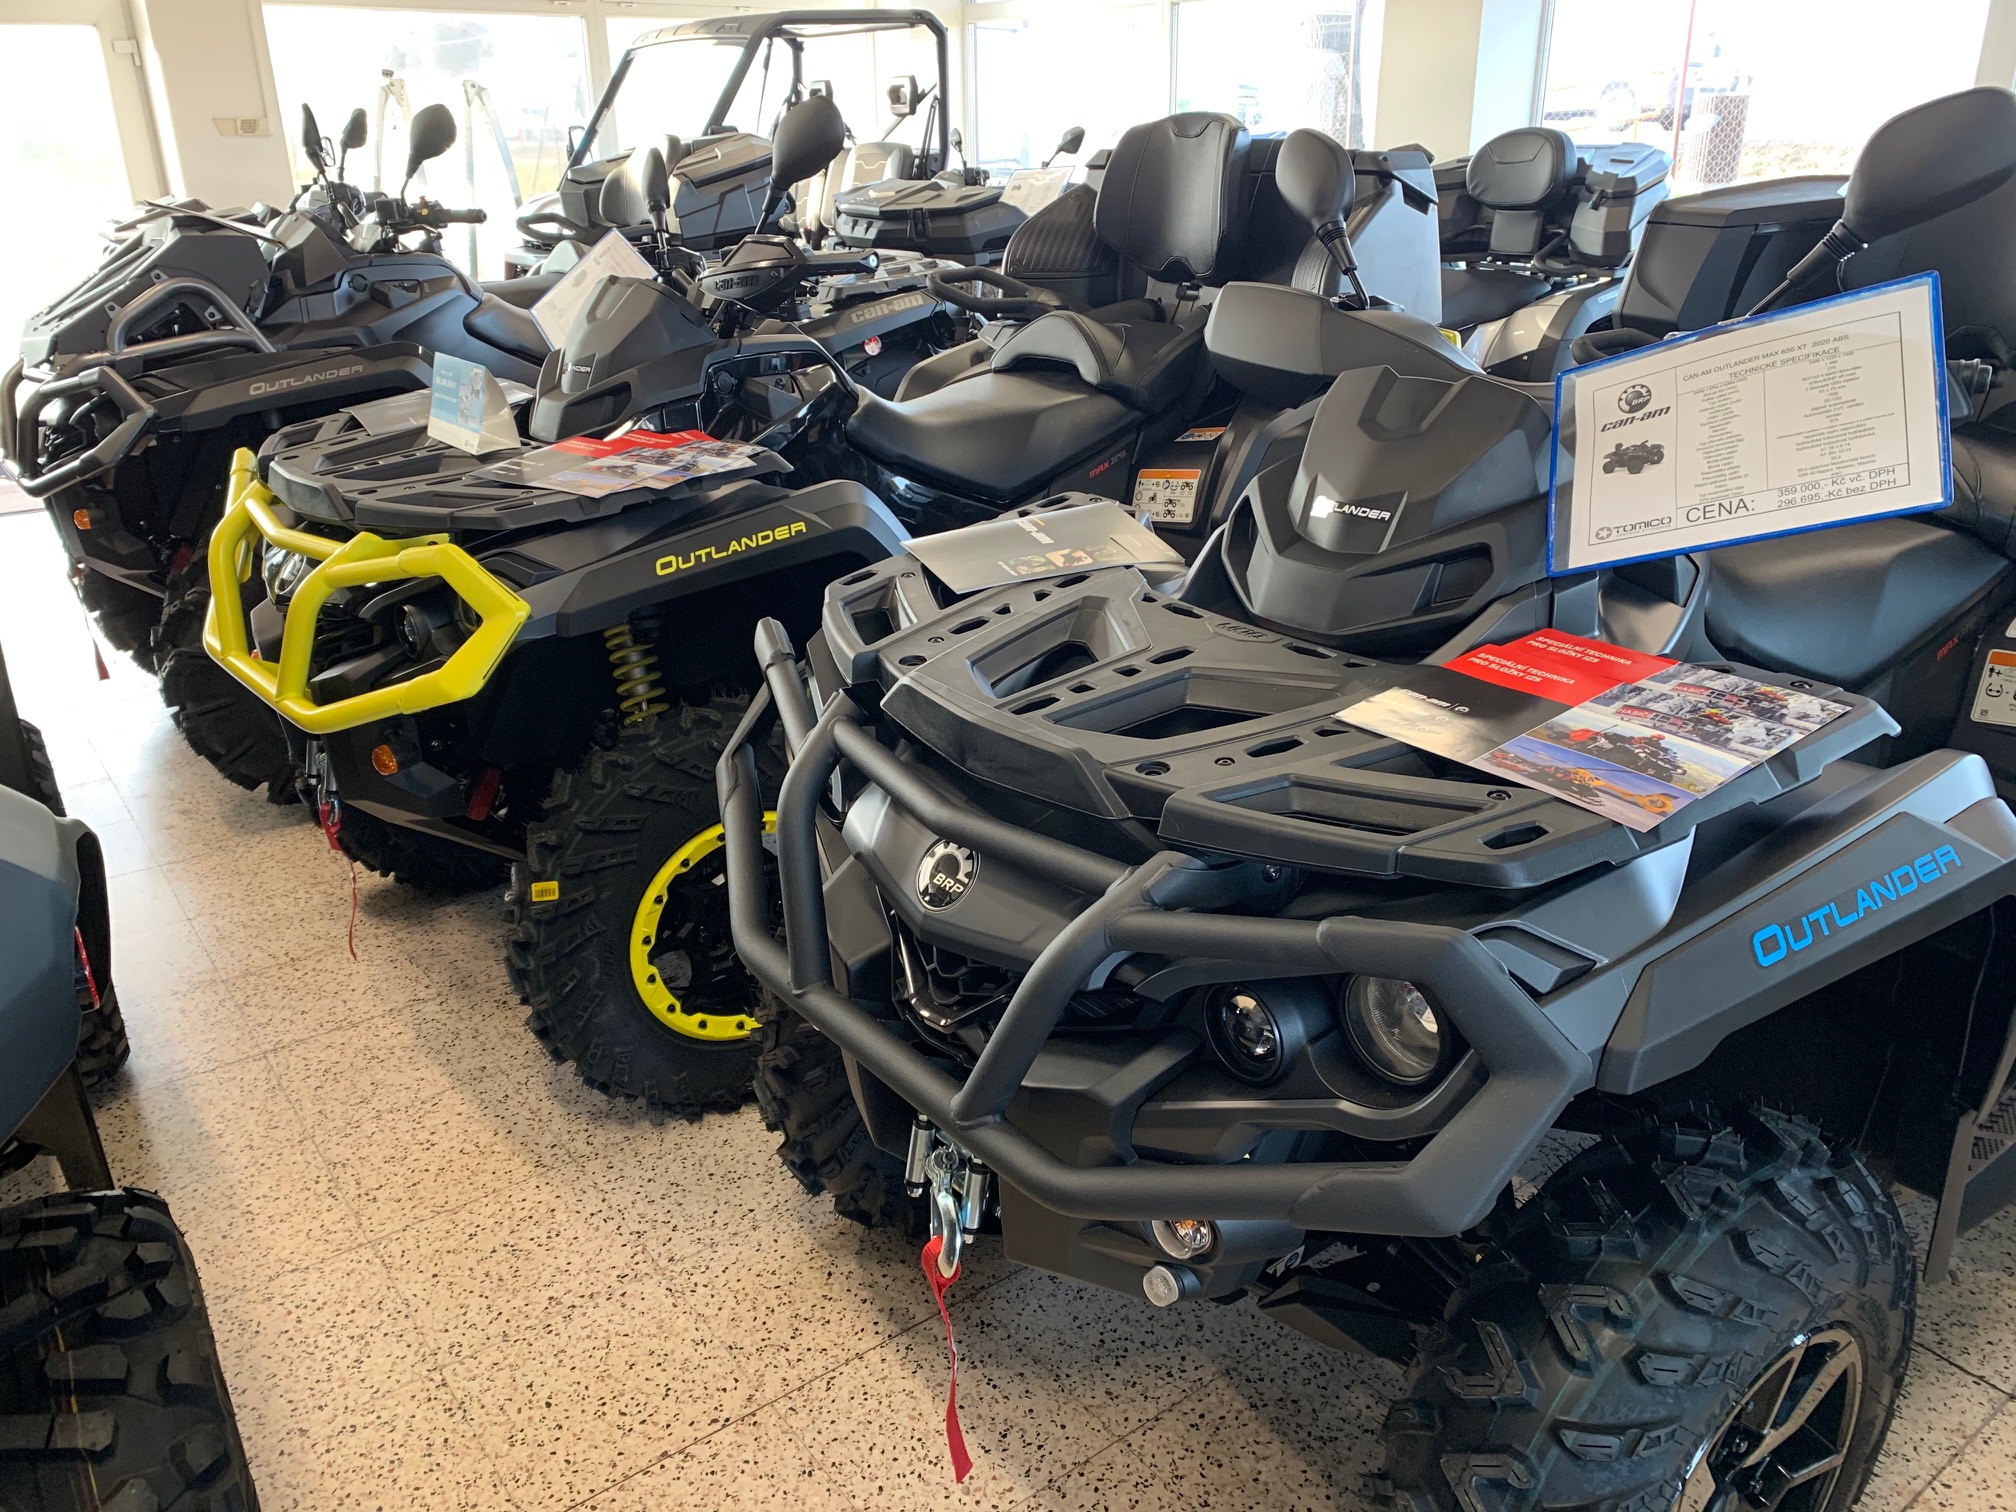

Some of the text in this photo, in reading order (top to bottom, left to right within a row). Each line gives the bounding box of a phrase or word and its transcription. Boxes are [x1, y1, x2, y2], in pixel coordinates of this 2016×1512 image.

[851, 294, 924, 323] can-am
[1683, 335, 1849, 381] CAN-AM OUTLANDER MAX 650 XT 2020 ABS
[1729, 360, 1777, 379] TECHNICKÉ
[1780, 346, 1840, 366] SPECIFIKACE
[249, 365, 363, 395] OUTLANDER
[1600, 406, 1671, 433] can-am
[1831, 477, 1846, 487] Kč
[1849, 474, 1865, 483] vč.
[1869, 467, 1896, 480] DPH
[1846, 486, 1867, 495] bez
[1870, 478, 1897, 490] DPH
[1686, 498, 1755, 523] CENA:
[1613, 516, 1672, 534] TOMICO
[655, 521, 807, 576] OUTLANDER
[1526, 640, 1600, 664] PRO SLOŽKY IZS
[1536, 636, 1632, 666] SPECIÁLNÍ TECHNIKA
[1467, 657, 1543, 683] PRO SLOŽKY IZS
[1477, 652, 1575, 685] SPECIÁLNÍ TECHNIKA
[932, 872, 965, 893] BRP
[1752, 844, 1962, 967] OUTLANDER
